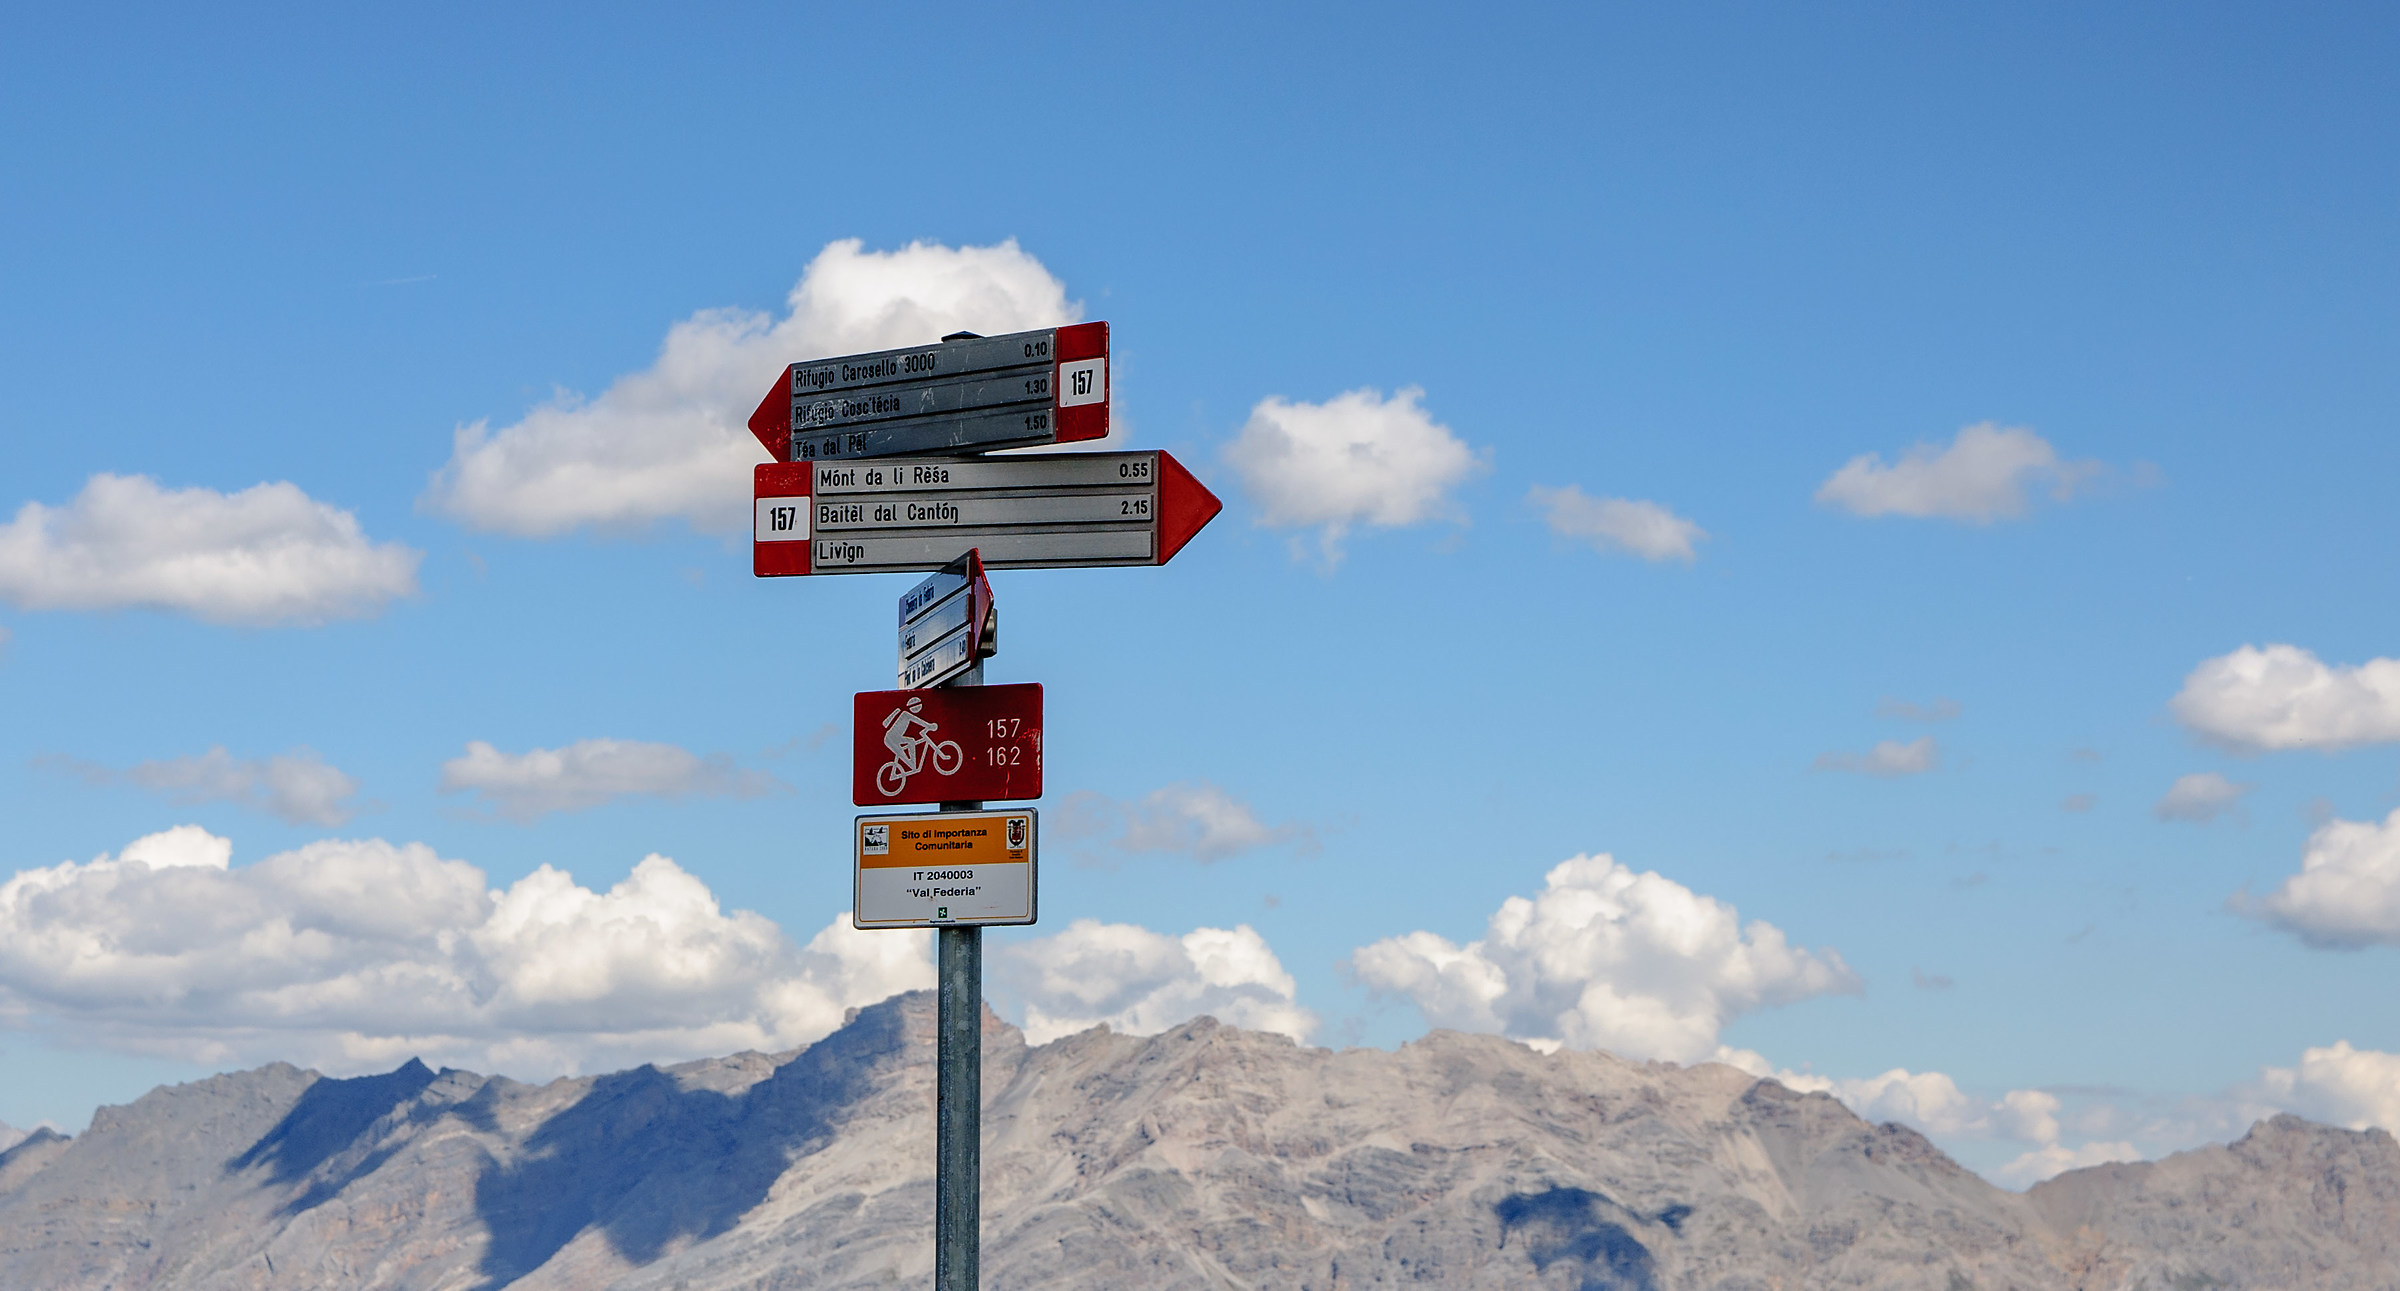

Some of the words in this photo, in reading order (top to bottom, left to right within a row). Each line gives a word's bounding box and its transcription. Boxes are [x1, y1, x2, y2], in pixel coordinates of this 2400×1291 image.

[1024, 341, 1048, 358] 0.10
[795, 367, 834, 389] Rifugio
[842, 359, 896, 381] Carosello
[905, 352, 935, 373] 3000
[1024, 378, 1048, 395] 1.30
[1071, 369, 1093, 395] 157
[795, 402, 834, 424] Rifugio
[1024, 414, 1047, 431] 1.50
[795, 440, 816, 458] Téa
[823, 437, 841, 456] dal
[820, 469, 855, 487] Mónt
[865, 468, 883, 486] da
[894, 467, 903, 485] li
[1119, 463, 1148, 478] 0.55
[820, 505, 864, 523] Baitèl
[874, 504, 898, 522] dal
[1121, 500, 1148, 515] 2.15
[770, 506, 796, 532] 157
[987, 718, 1021, 739] 157
[987, 746, 1021, 767] 162
[901, 830, 920, 840] Sito
[922, 829, 931, 839] di
[934, 828, 988, 839] Importanza
[915, 842, 973, 851] Comunitaria
[913, 872, 924, 881] IT
[927, 870, 974, 881] 2040003
